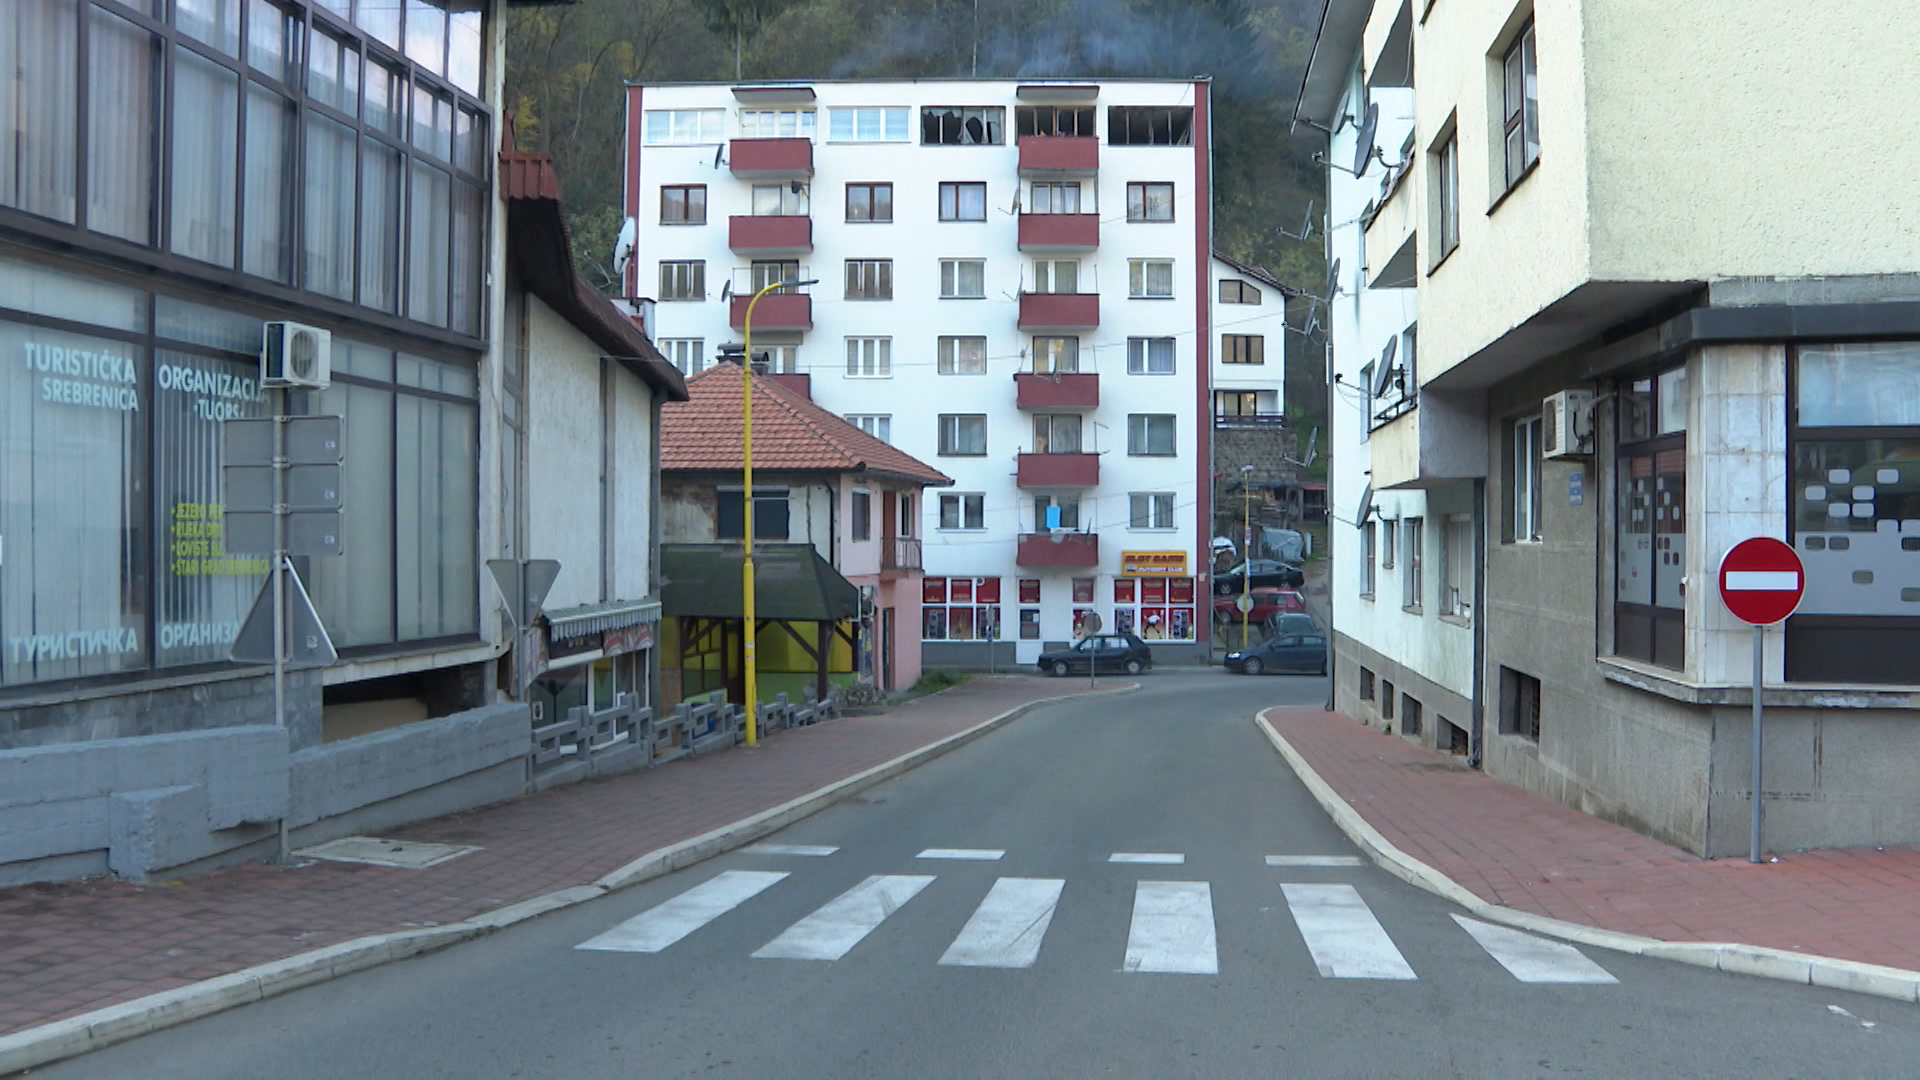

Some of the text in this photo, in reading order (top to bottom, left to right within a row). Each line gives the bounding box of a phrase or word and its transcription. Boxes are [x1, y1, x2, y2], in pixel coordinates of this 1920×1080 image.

[24, 341, 137, 384] TURISTIČKA
[42, 377, 139, 412] SREBRENICA
[10, 627, 138, 664] ТУРИСТИЧКА
